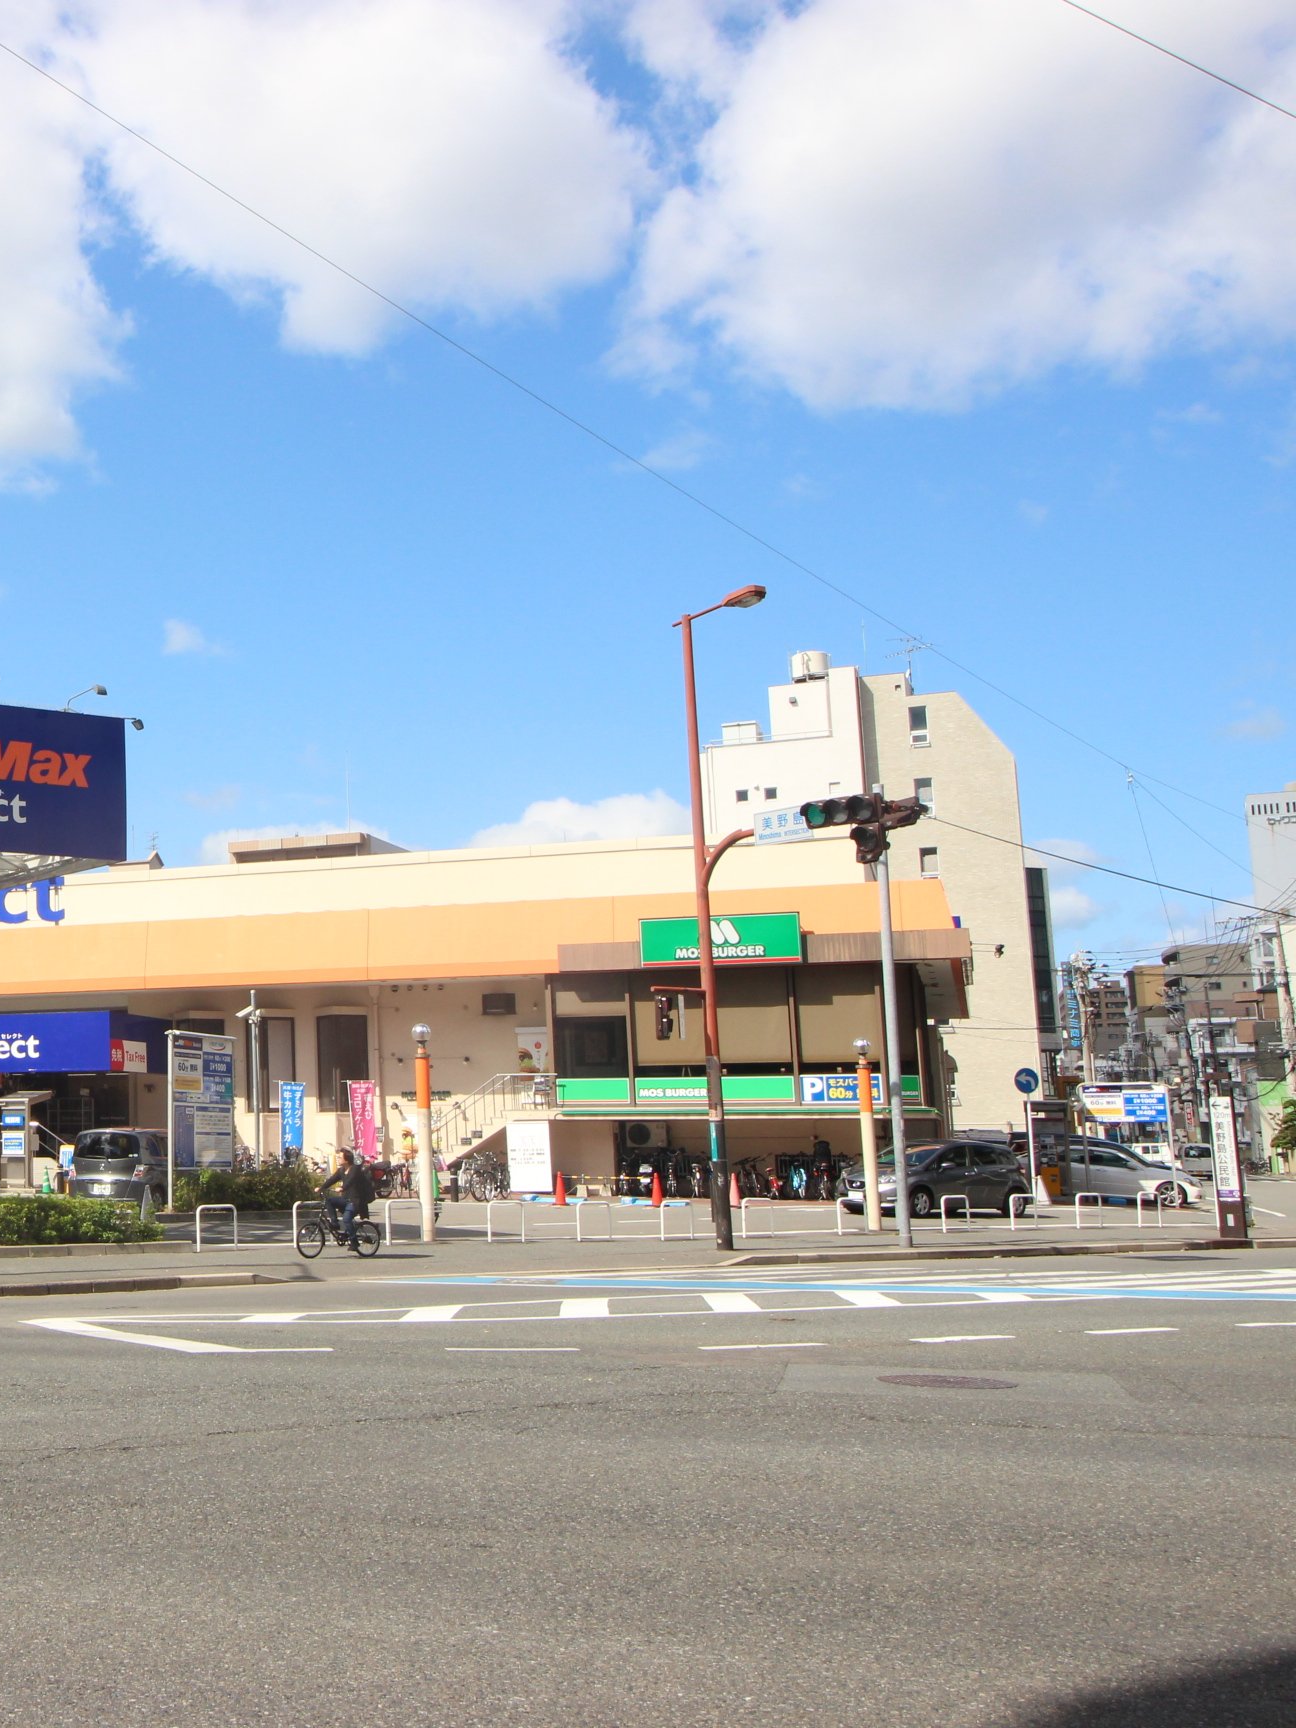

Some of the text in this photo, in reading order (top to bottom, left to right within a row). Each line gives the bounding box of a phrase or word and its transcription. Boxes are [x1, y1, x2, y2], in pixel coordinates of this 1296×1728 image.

[761, 811, 804, 831] 美野島
[712, 945, 765, 958] BURGER
[125, 1050, 146, 1064] Tax Free
[802, 1077, 824, 1101] P
[828, 1078, 879, 1087] モスバーー
[639, 1087, 708, 1098] MOS BURGER
[828, 1087, 853, 1099] 60分
[1215, 1121, 1231, 1187] 美野島公民館
